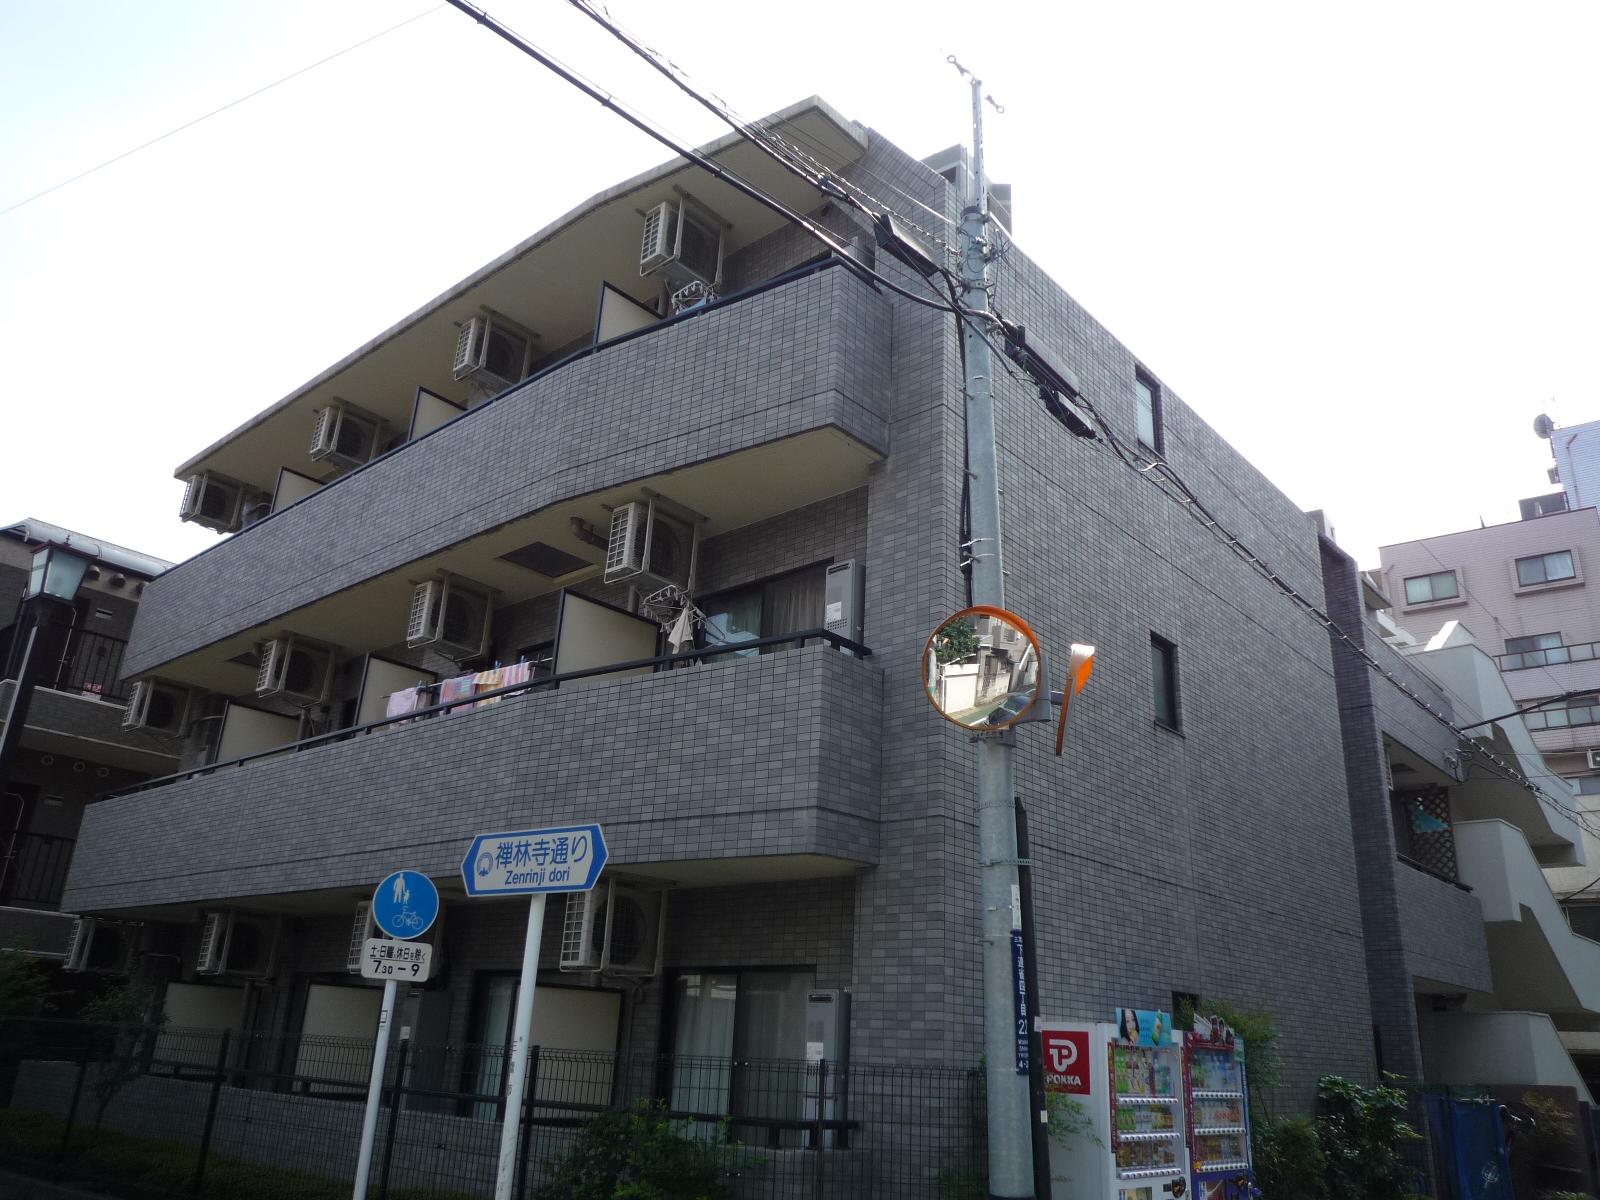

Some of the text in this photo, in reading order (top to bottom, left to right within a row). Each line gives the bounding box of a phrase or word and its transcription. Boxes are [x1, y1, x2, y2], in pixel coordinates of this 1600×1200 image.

[495, 836, 588, 869] 禅林寺通り
[505, 867, 570, 886] Zenrinji dori
[1046, 1074, 1082, 1087] POKKA
